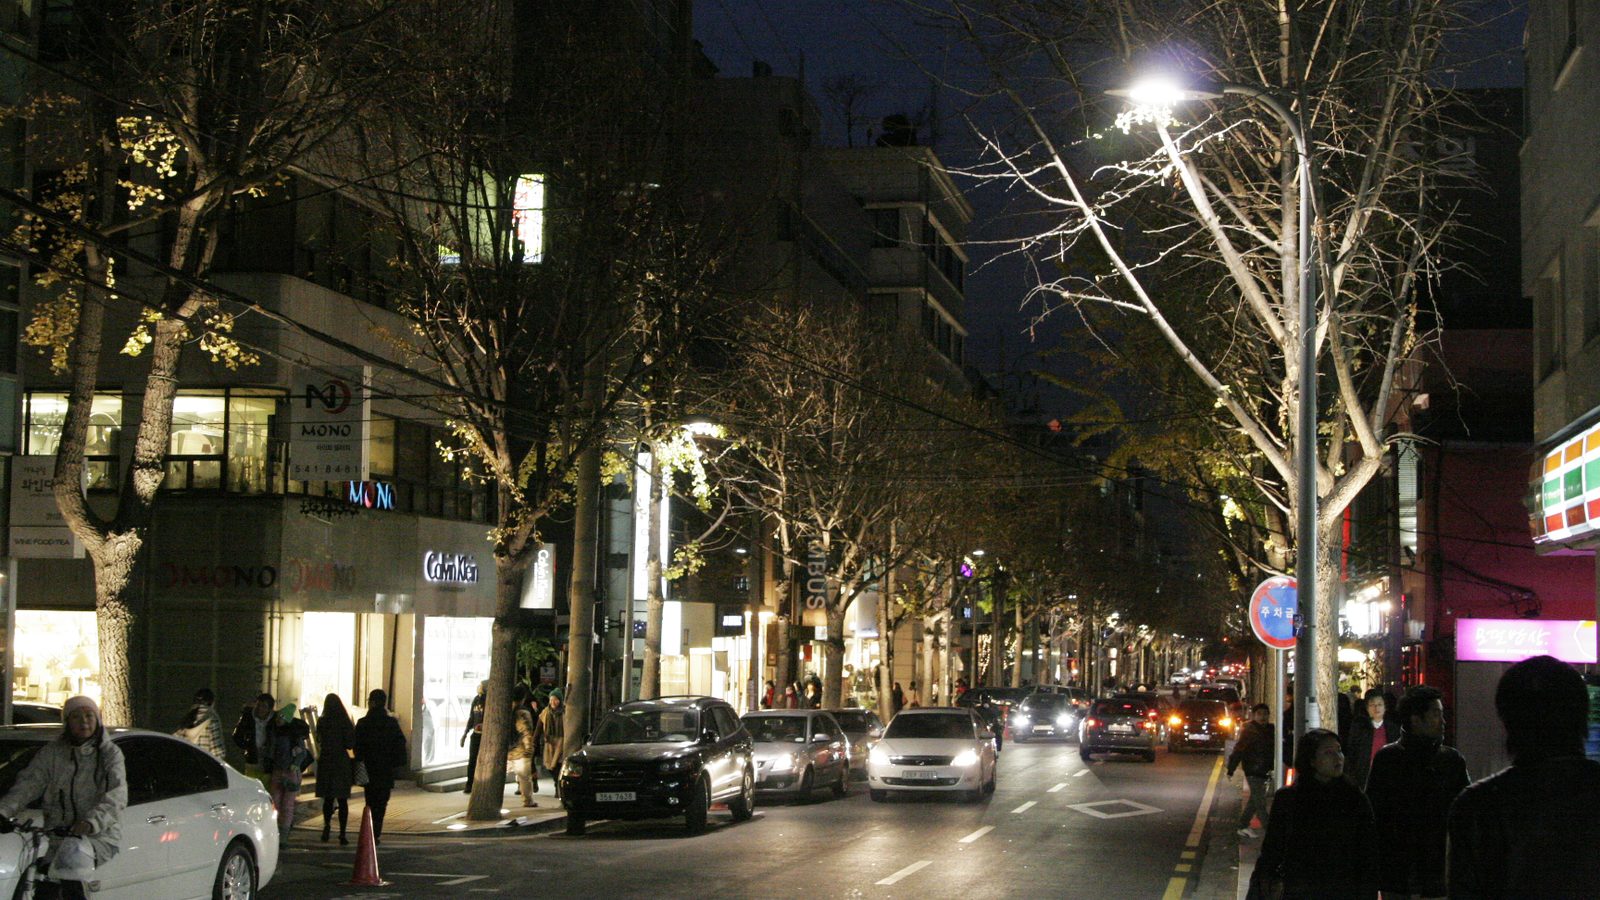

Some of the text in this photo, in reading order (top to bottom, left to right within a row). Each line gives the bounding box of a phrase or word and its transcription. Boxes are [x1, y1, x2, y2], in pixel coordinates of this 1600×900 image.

[302, 424, 351, 437] MONO
[424, 551, 479, 584] Calvin Klein
